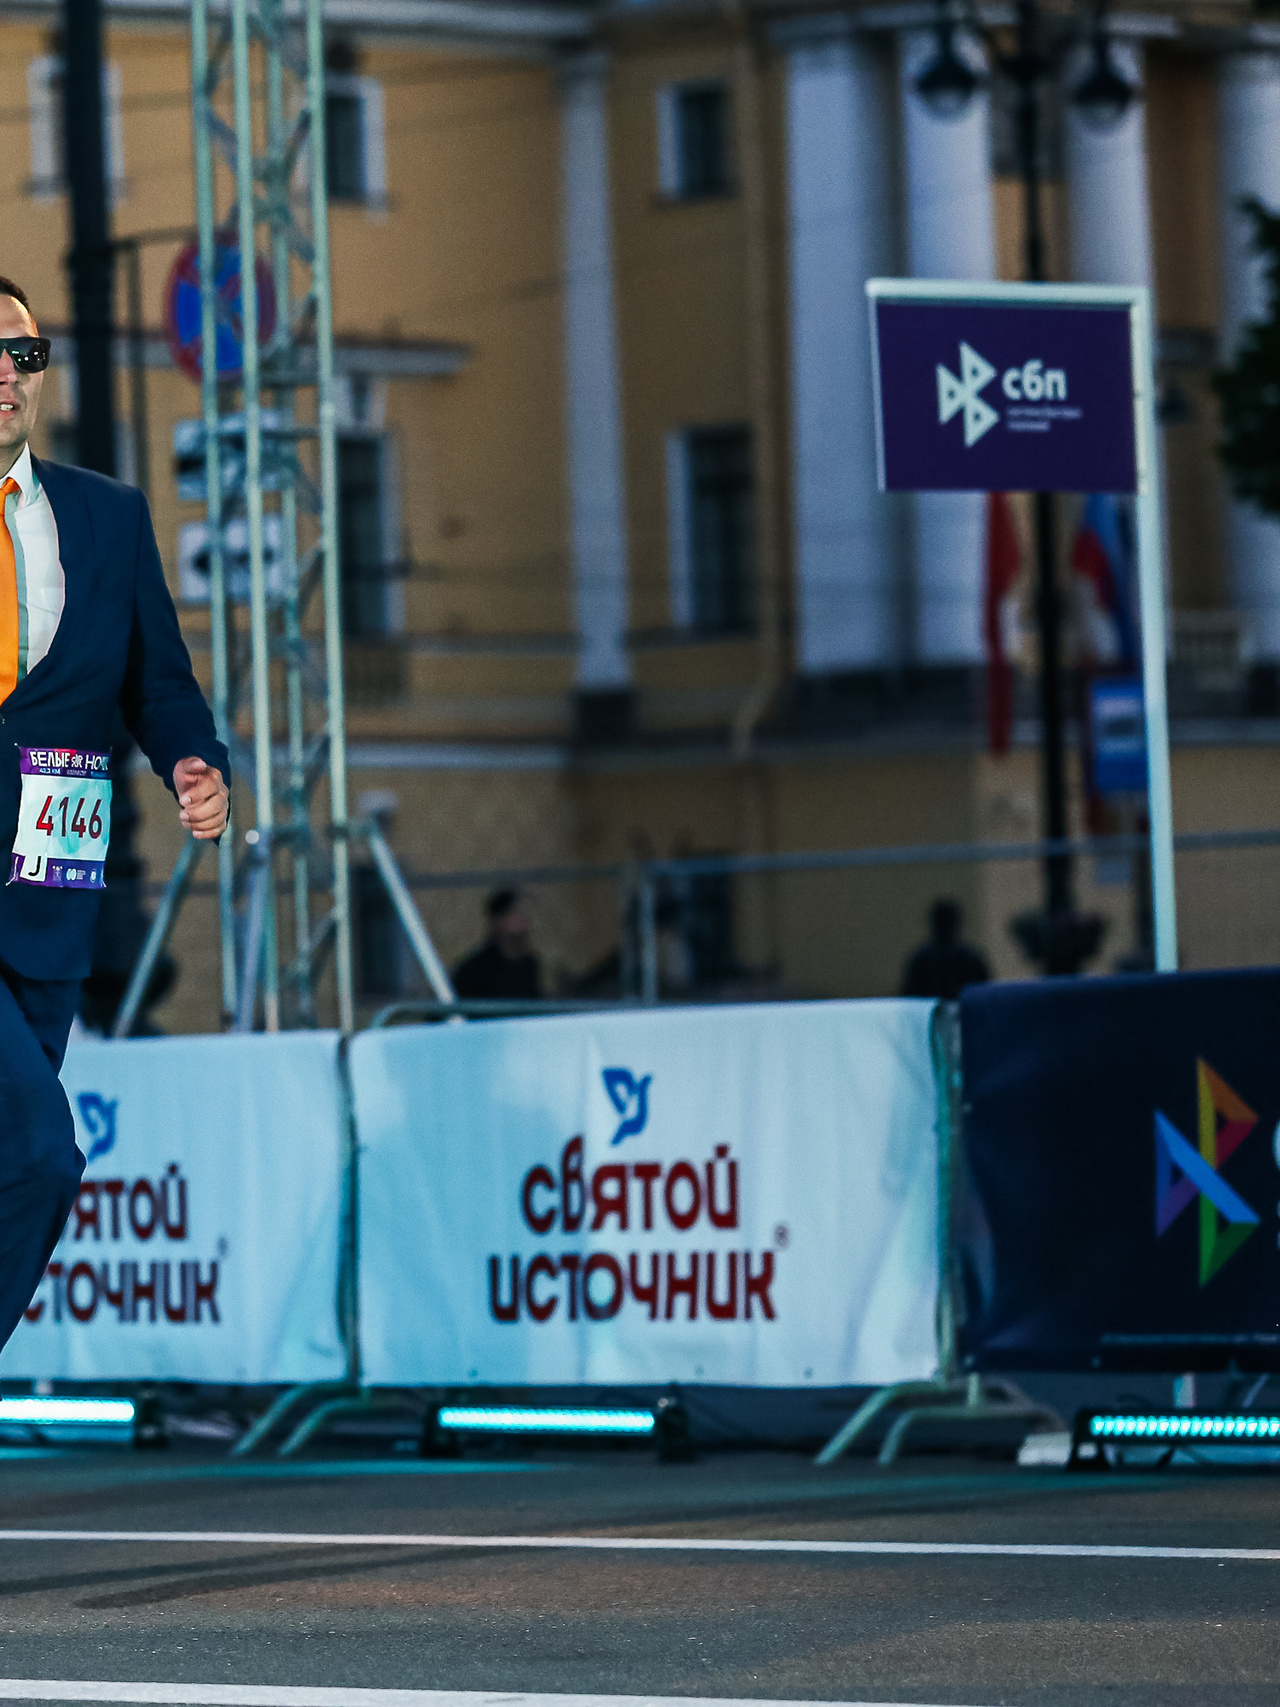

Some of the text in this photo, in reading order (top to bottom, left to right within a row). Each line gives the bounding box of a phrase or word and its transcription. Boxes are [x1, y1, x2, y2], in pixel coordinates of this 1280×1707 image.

[29, 751, 71, 768] БЕЛЫЕ
[35, 795, 103, 839] 4146
[73, 1162, 187, 1242] ятой
[24, 1261, 221, 1323] точник
